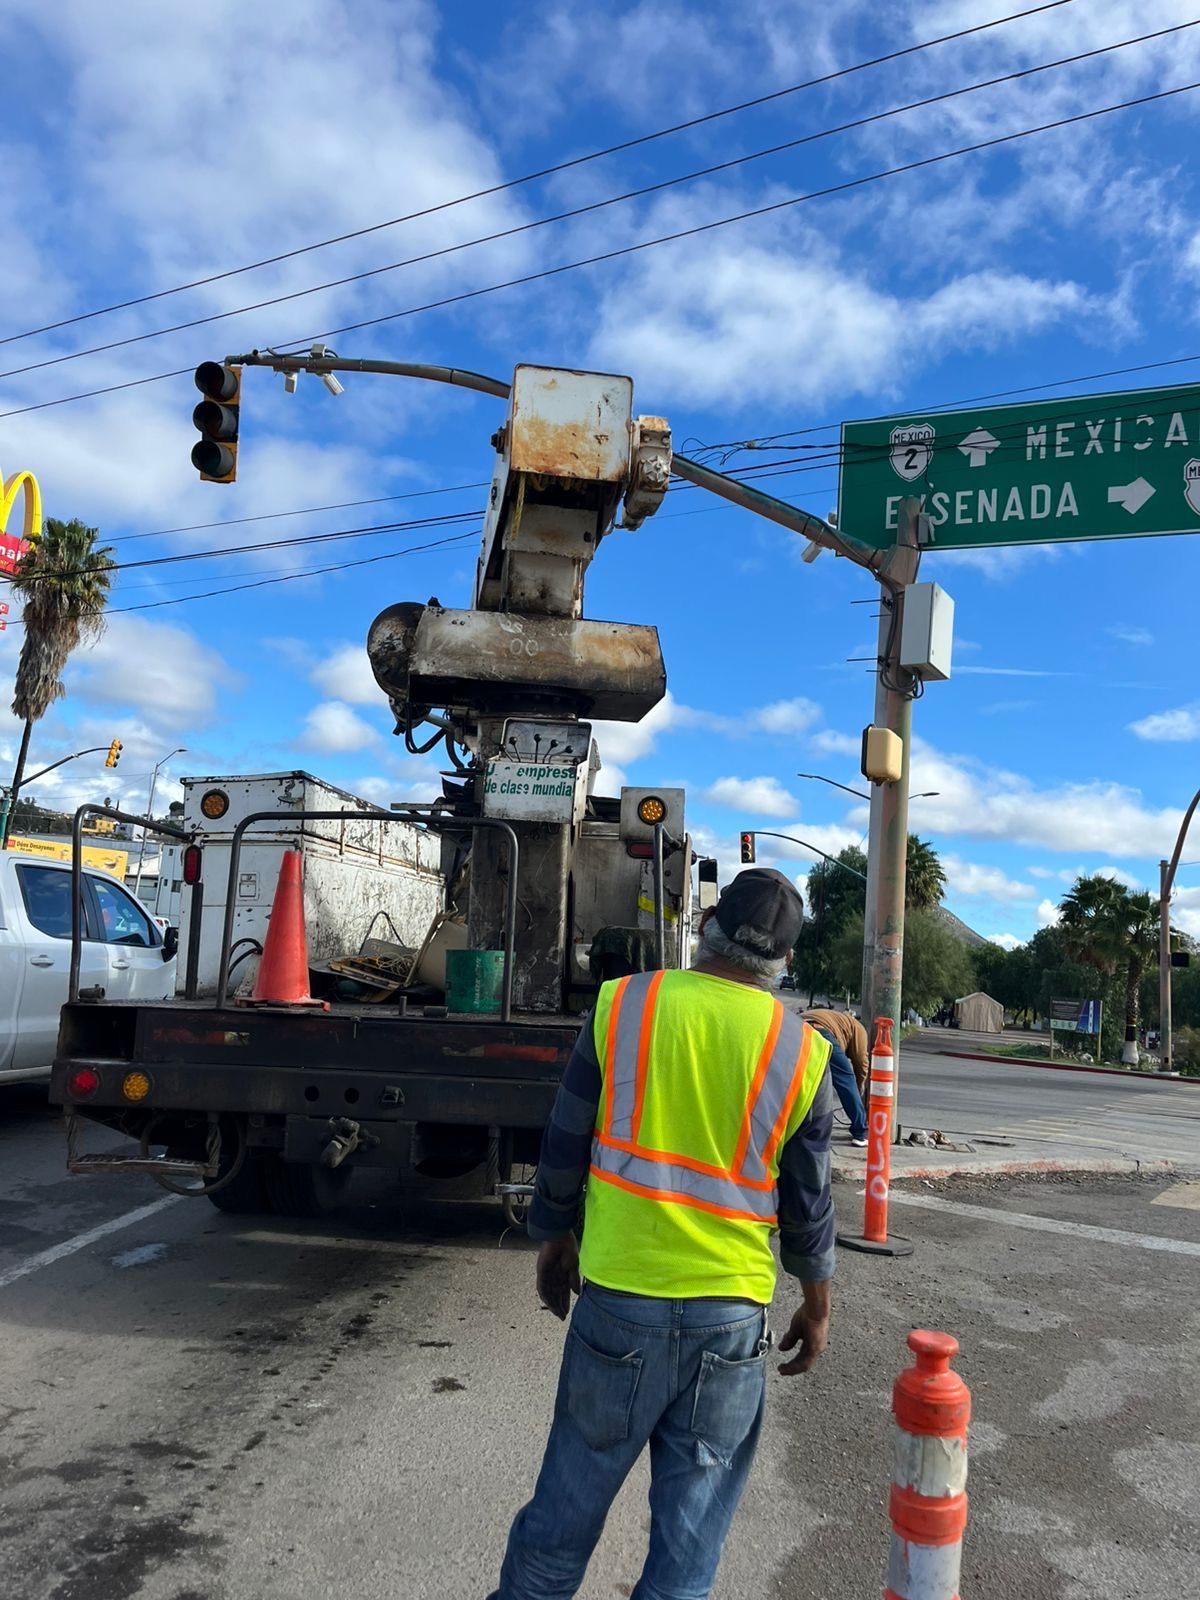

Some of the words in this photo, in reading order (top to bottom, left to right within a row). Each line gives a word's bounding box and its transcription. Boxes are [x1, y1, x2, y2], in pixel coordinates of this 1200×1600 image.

[894, 430, 931, 444] MEXICO
[1026, 411, 1200, 460] MEXICA
[904, 448, 918, 470] 2
[885, 481, 1079, 530] ESENADA
[516, 765, 576, 780] empresa
[484, 778, 497, 793] de
[500, 779, 529, 794] clase
